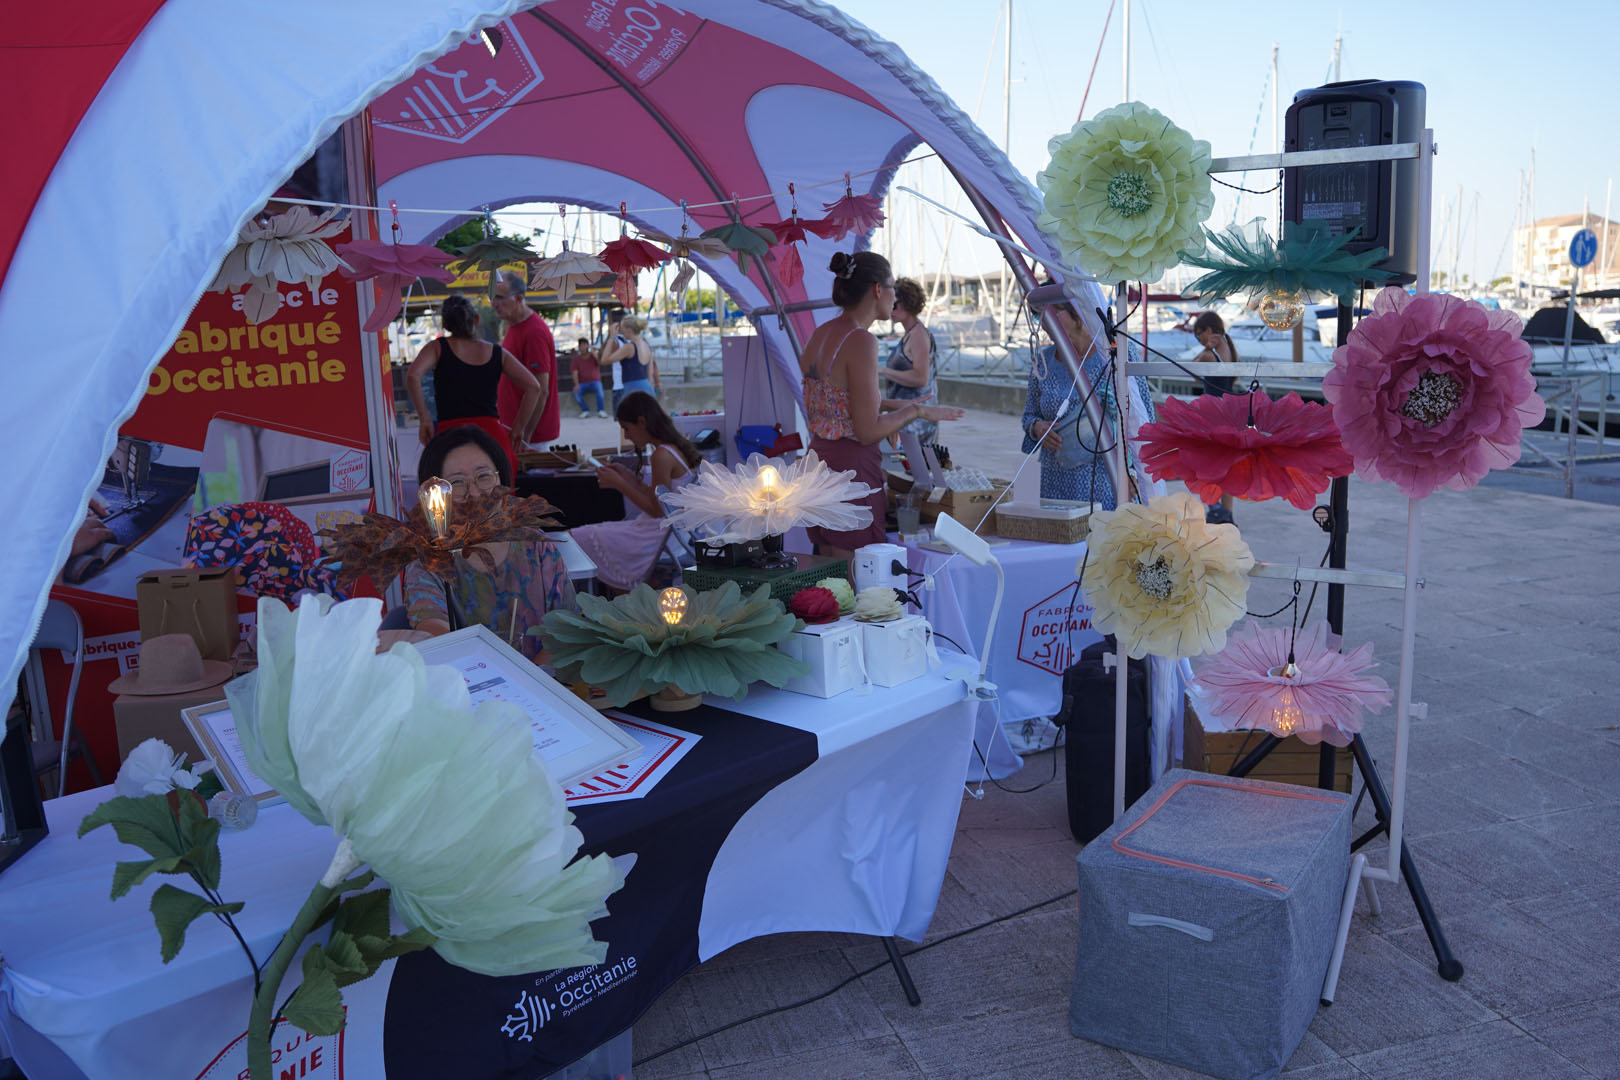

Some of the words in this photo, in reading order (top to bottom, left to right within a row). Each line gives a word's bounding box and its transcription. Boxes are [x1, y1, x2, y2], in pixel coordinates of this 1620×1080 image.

[231, 289, 303, 311] ac
[312, 287, 339, 306] le
[173, 311, 342, 355] abriqué
[1038, 604, 1097, 617] FABRIQU
[1031, 618, 1092, 638] OCCITANI
[535, 977, 545, 987] En
[554, 982, 566, 993] La
[566, 963, 598, 985] Région
[559, 956, 637, 1008] Occitanie
[562, 998, 593, 1017] Pyrénées
